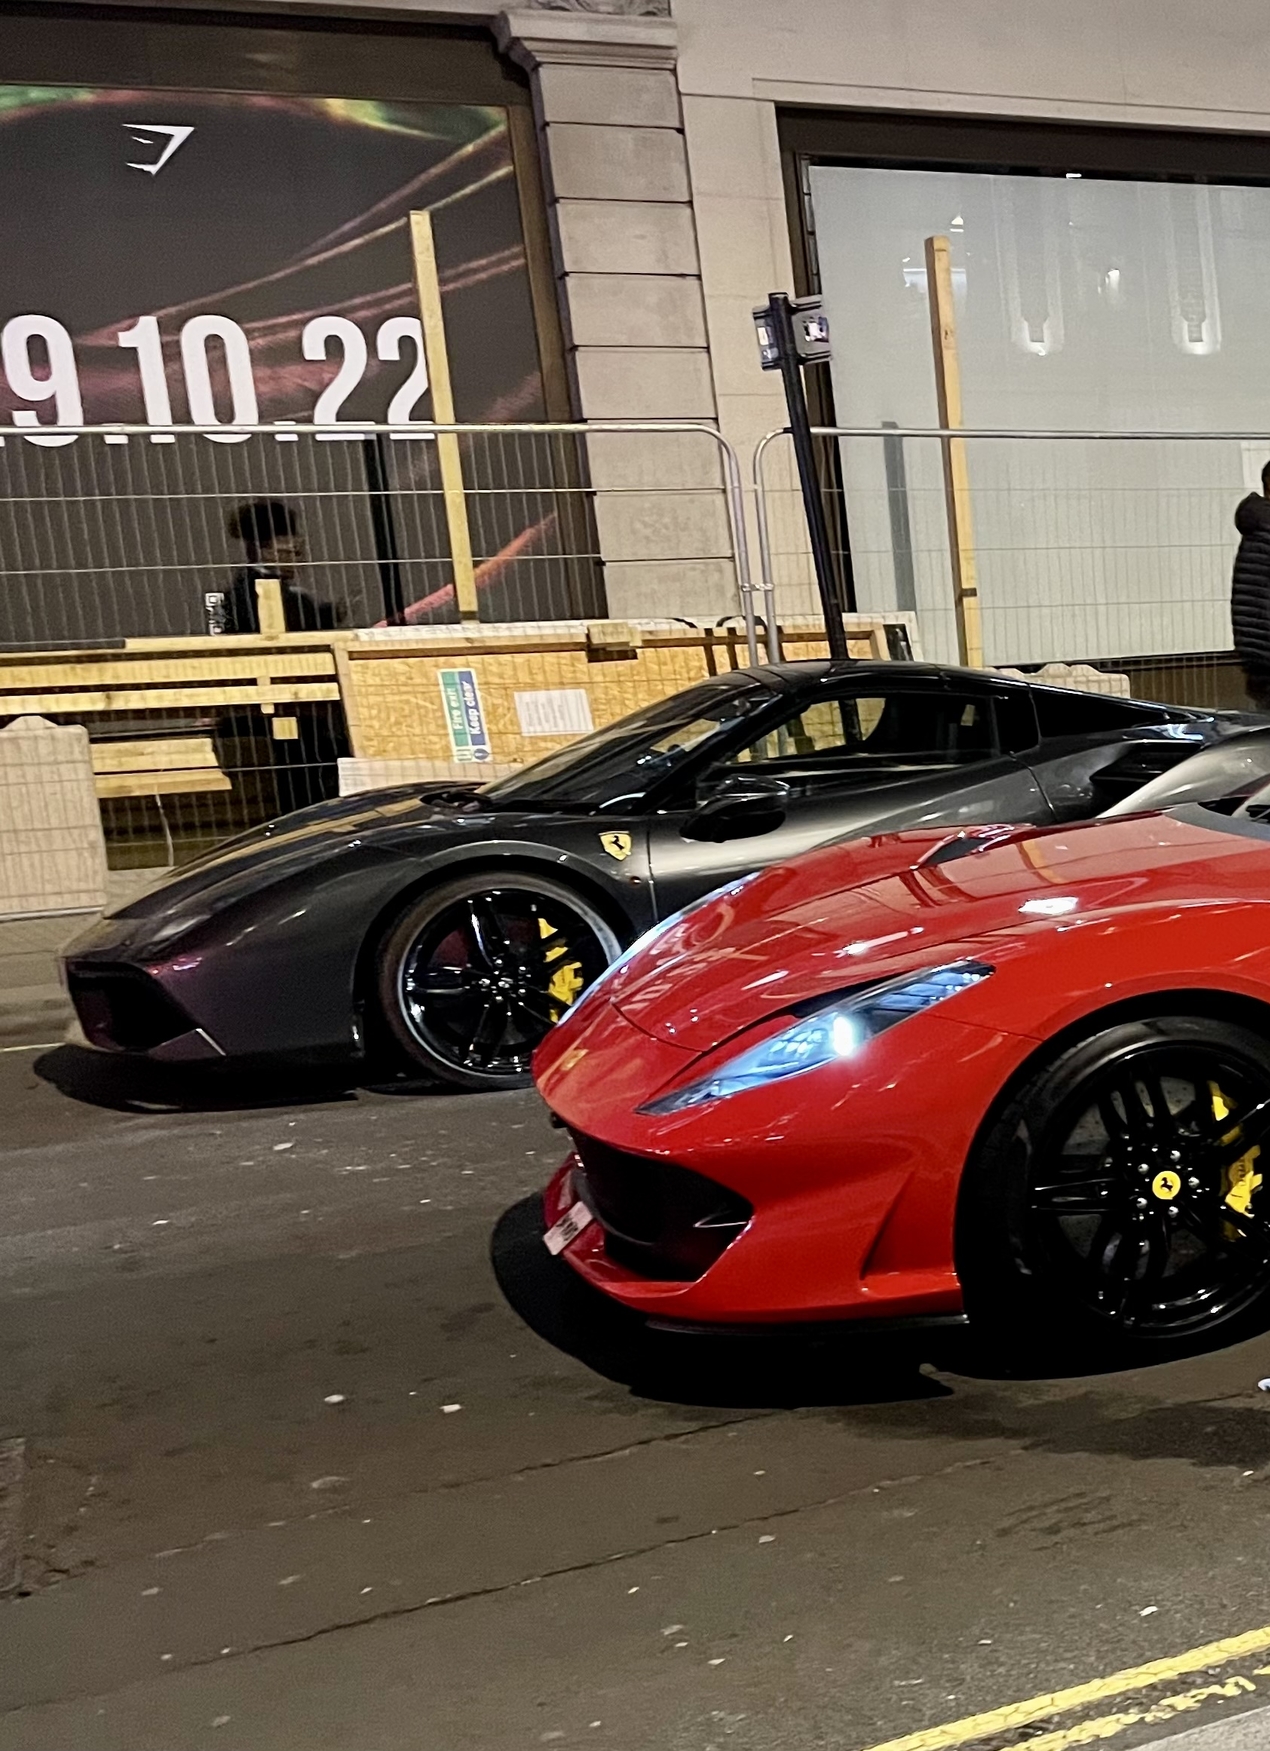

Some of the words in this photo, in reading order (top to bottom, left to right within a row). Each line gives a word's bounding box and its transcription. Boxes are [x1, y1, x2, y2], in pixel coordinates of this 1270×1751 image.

[0, 314, 435, 447] 9.10.22
[446, 687, 460, 707] exit
[461, 680, 475, 706] clear
[451, 708, 464, 730] Fire
[468, 709, 481, 735] Keep
